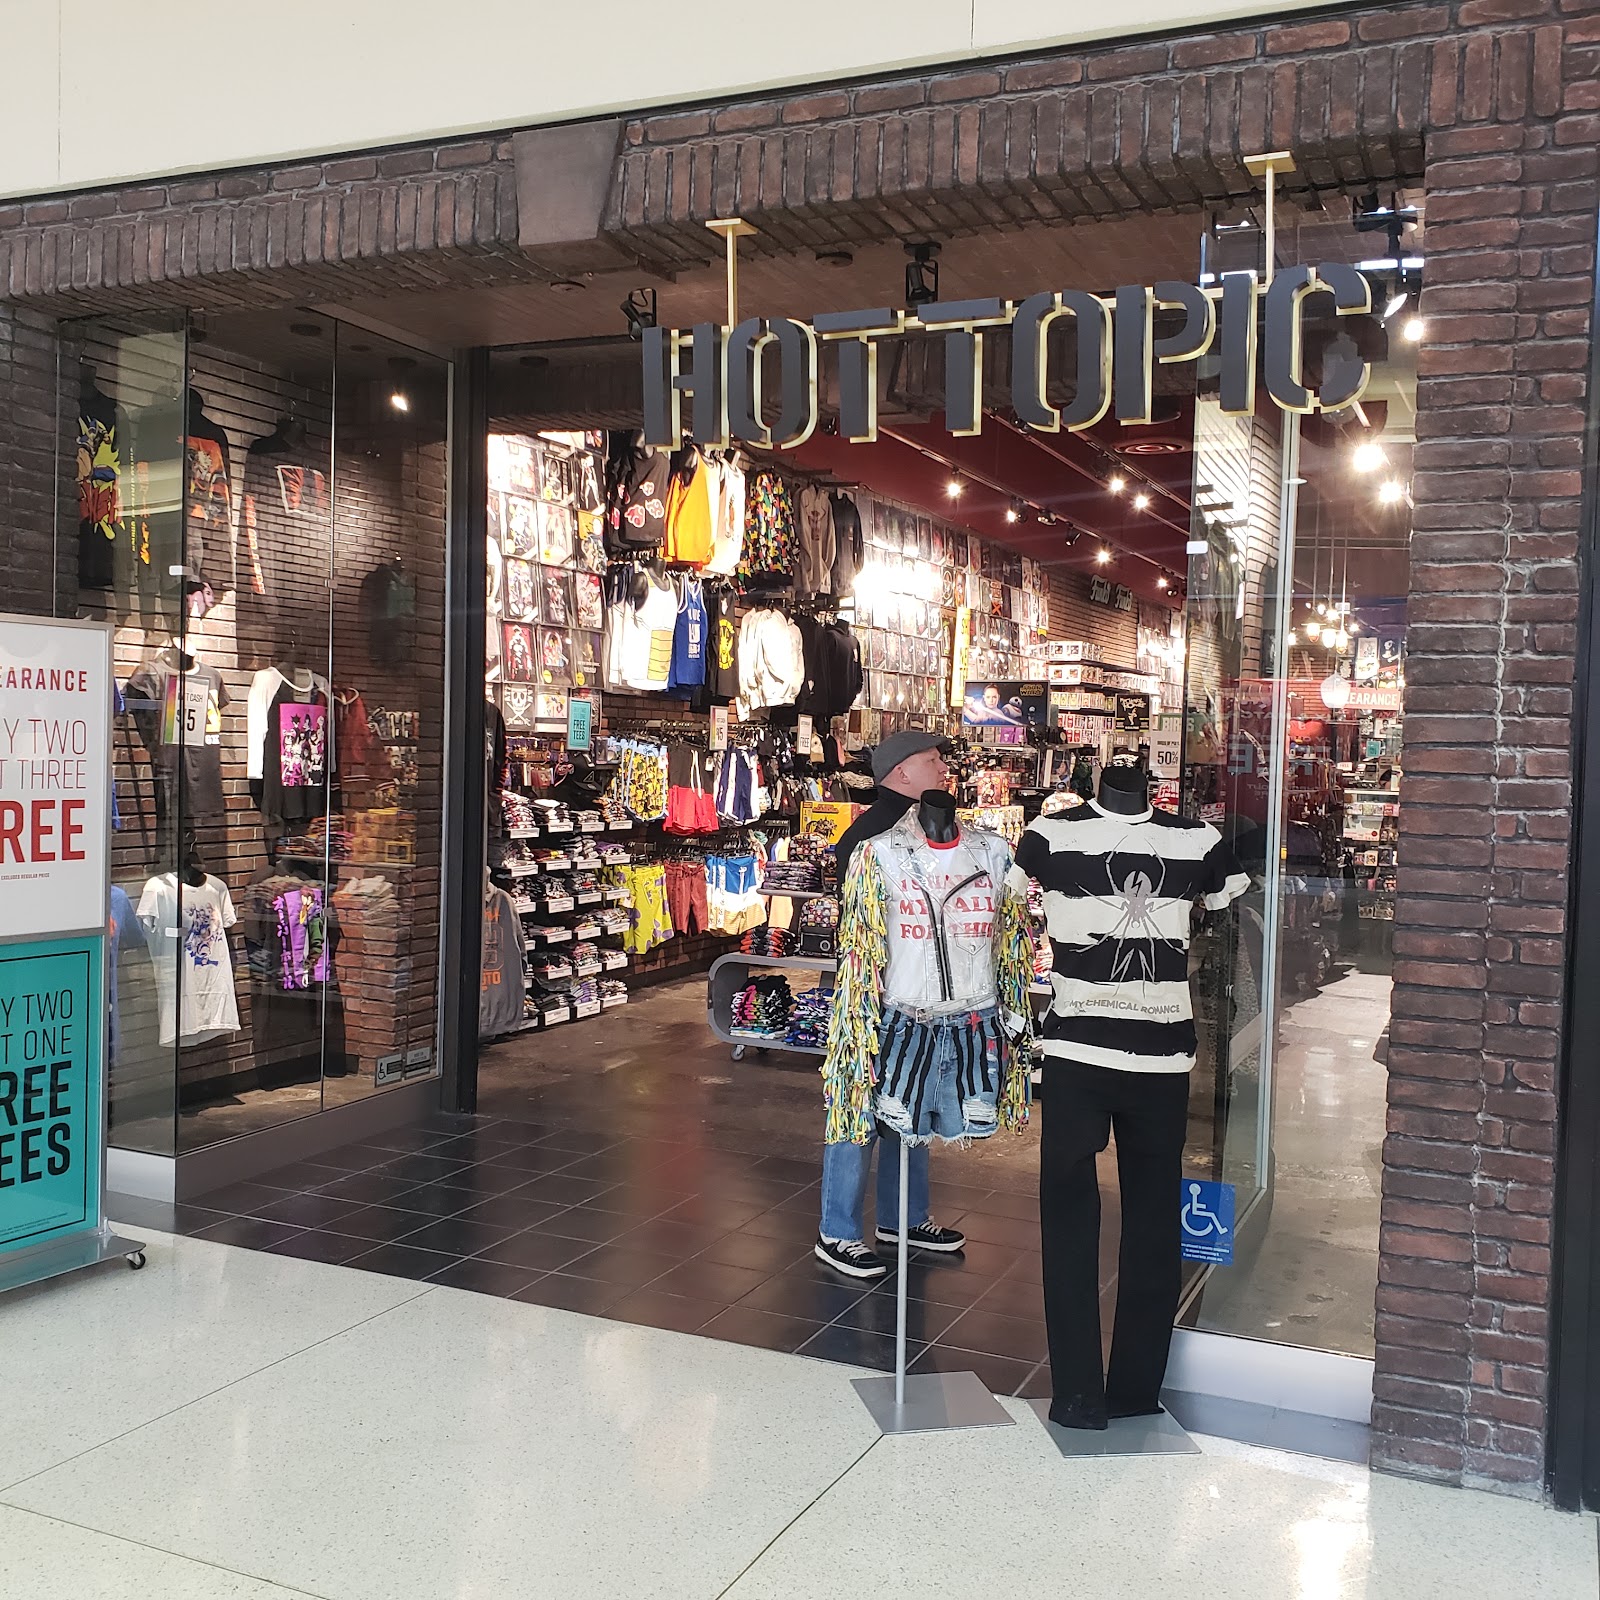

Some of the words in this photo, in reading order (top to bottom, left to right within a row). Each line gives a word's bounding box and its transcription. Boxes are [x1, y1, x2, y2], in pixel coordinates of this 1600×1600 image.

[643, 307, 903, 450] HOT
[917, 262, 1371, 437] TOPIC
[0, 666, 87, 692] ARANCE
[3, 718, 20, 754] Y
[28, 719, 87, 755] TWO
[1162, 717, 1194, 732] BIRS
[17, 759, 87, 790] THREE
[1157, 751, 1179, 765] 50%
[0, 800, 85, 863] REE
[899, 898, 928, 915] MY
[0, 997, 15, 1028] Y
[22, 989, 73, 1025] TWO
[1069, 1000, 1084, 1009] MY
[1085, 999, 1139, 1011] CHEMICAL
[1140, 1004, 1180, 1015] ROMANCE
[24, 1025, 73, 1061] ONE
[0, 1060, 72, 1127] REE
